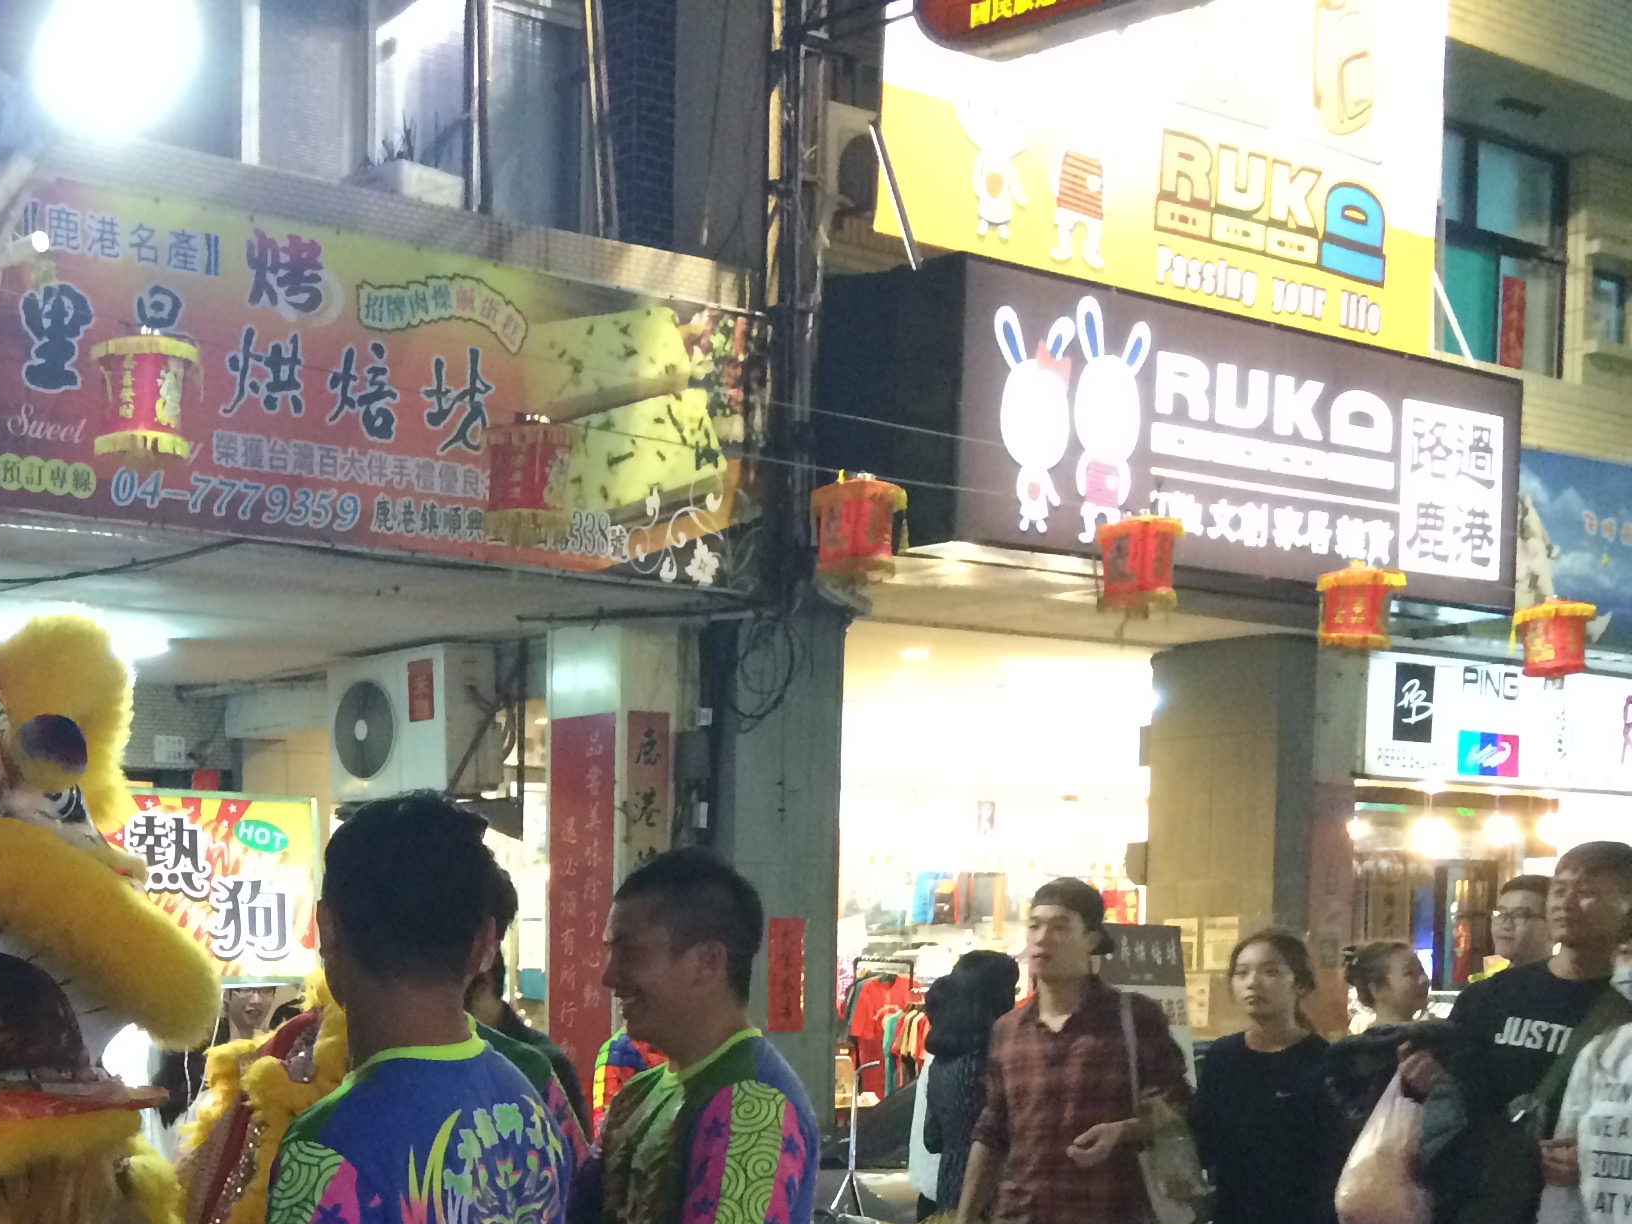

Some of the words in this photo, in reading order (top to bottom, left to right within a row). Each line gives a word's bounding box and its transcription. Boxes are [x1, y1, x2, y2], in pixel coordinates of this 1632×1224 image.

[1272, 276, 1326, 315] your
[1339, 288, 1382, 335] life
[8, 403, 88, 444] Sweet
[1463, 666, 1519, 701] PING
[634, 727, 662, 862] 鹿港
[238, 822, 286, 850] HOT
[128, 812, 294, 961] 熱狗
